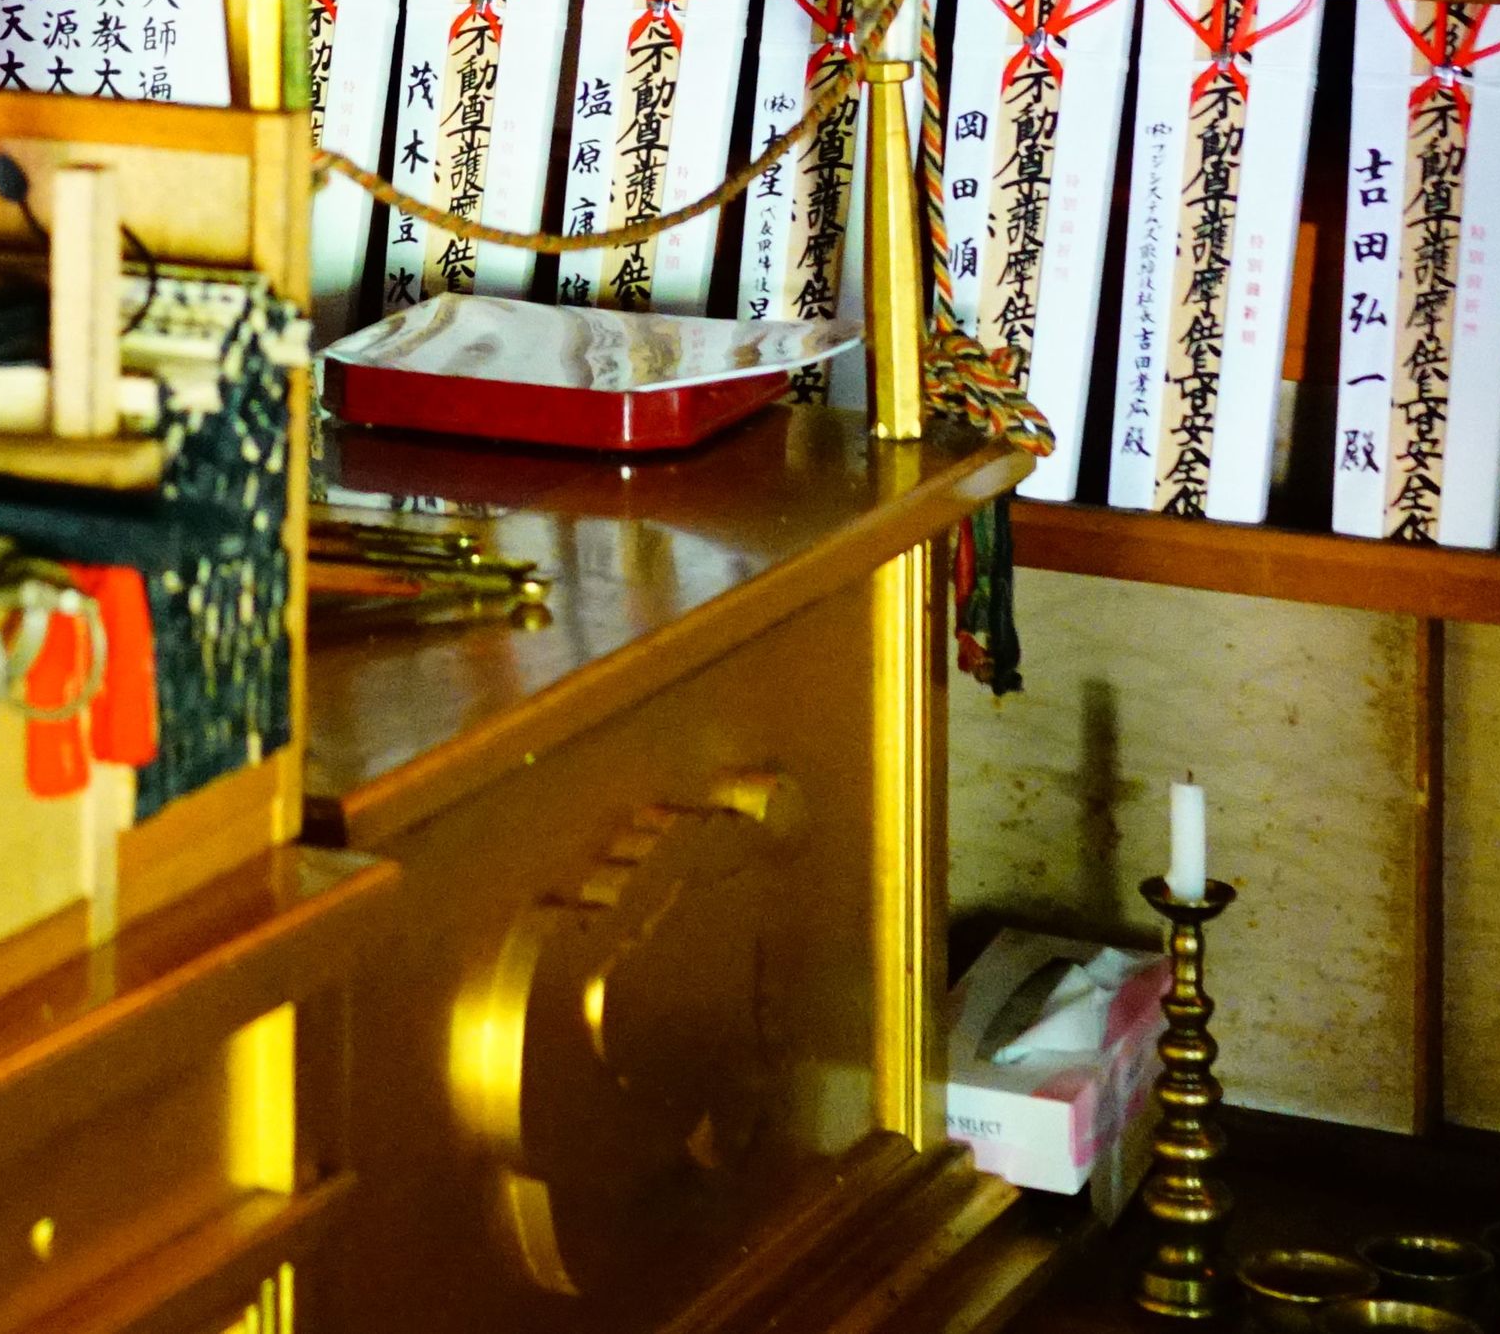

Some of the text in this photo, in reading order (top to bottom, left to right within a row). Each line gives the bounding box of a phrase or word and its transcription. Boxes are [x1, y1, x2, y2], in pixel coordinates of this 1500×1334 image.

[1339, 147, 1394, 477] 吉田弘一殿
